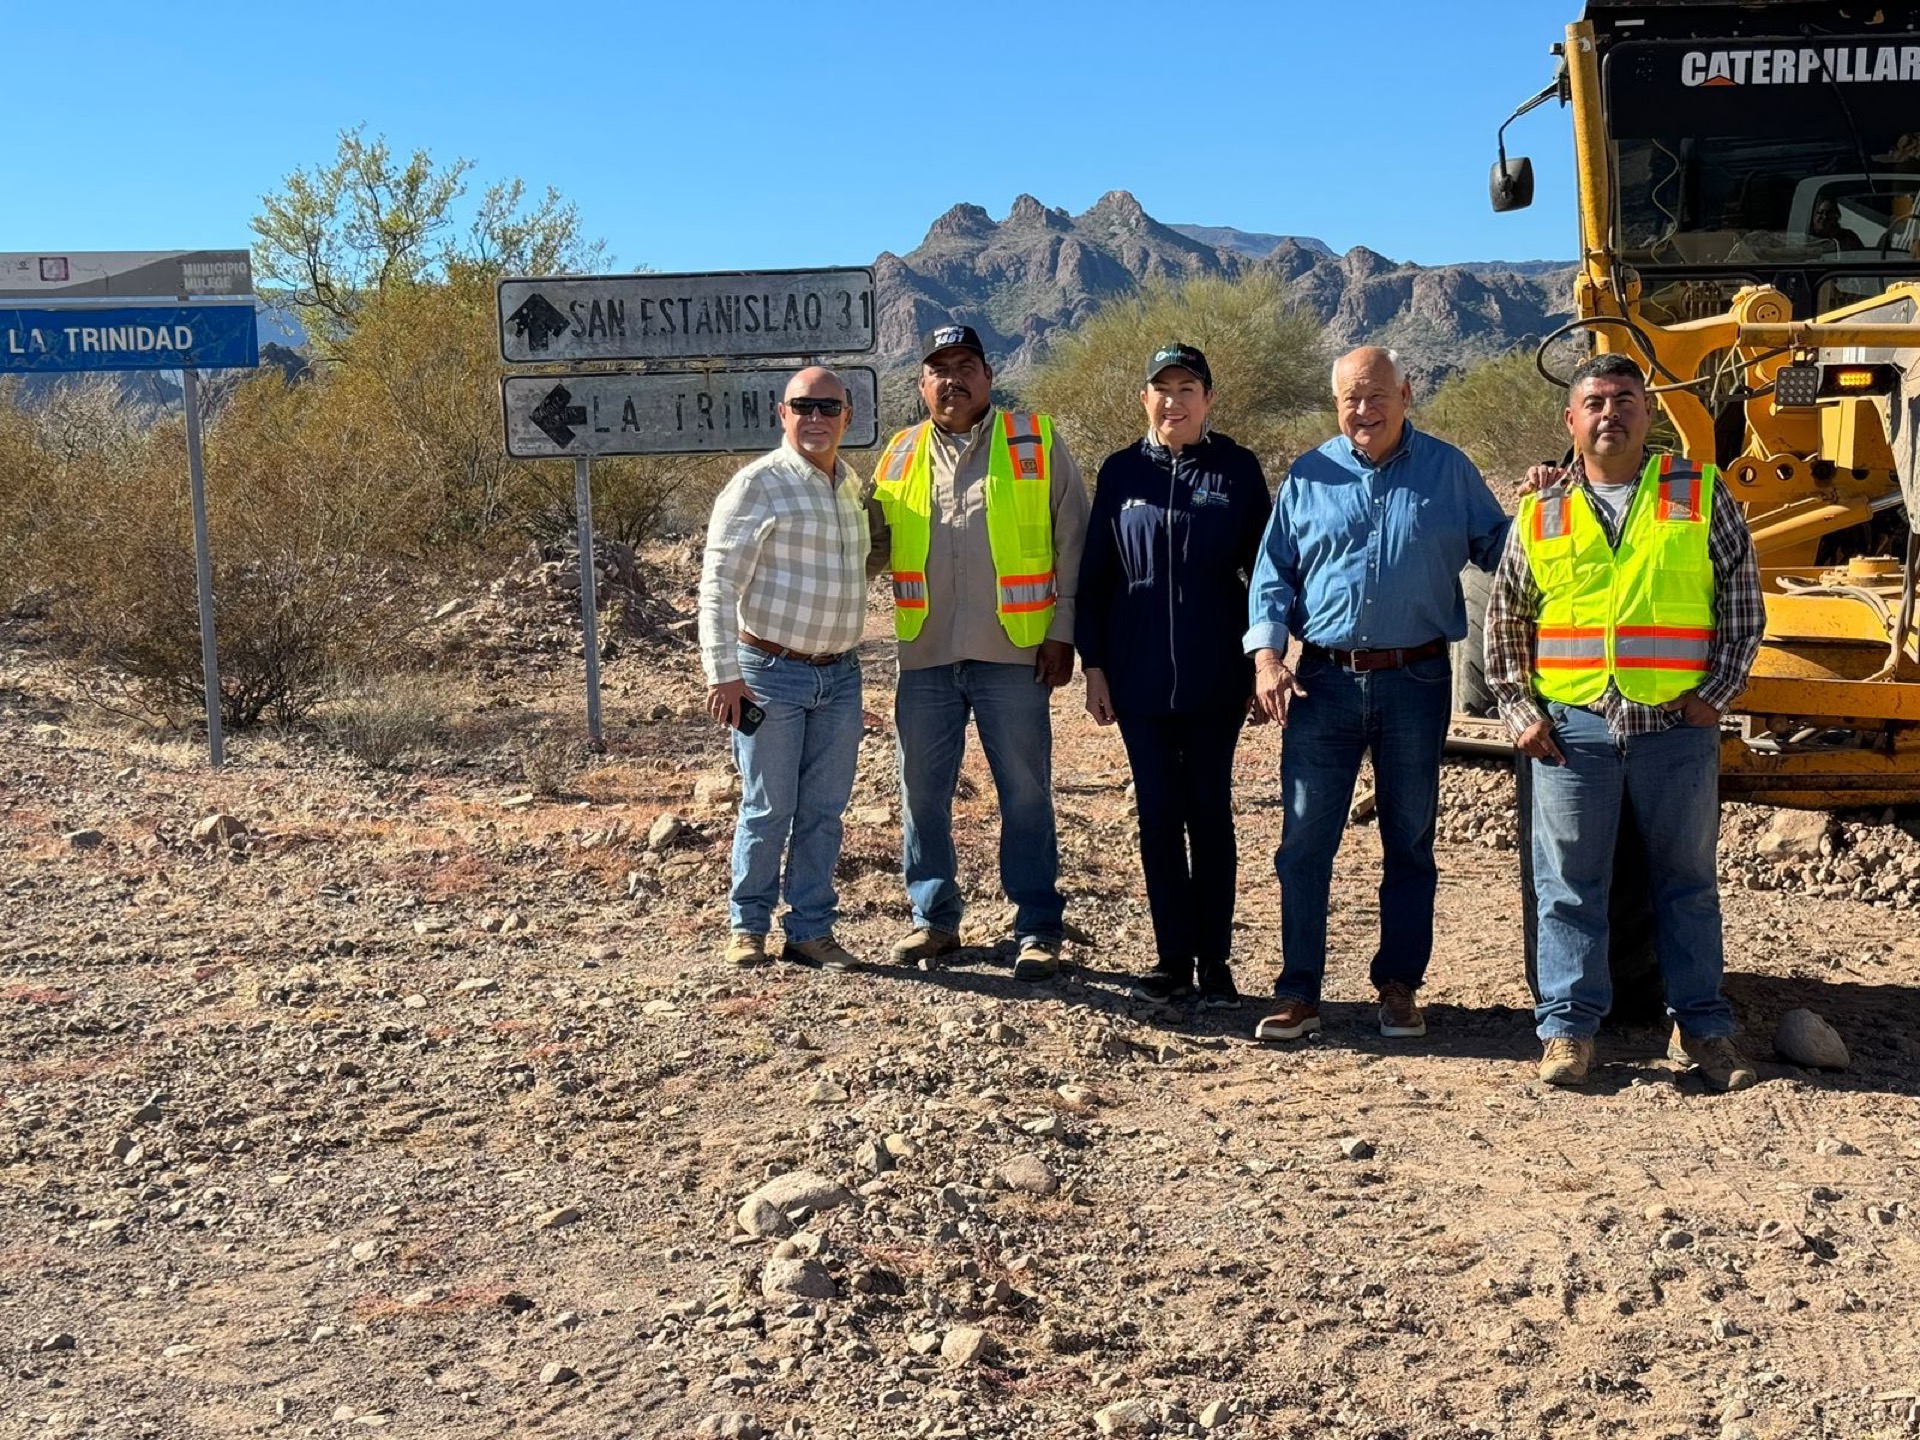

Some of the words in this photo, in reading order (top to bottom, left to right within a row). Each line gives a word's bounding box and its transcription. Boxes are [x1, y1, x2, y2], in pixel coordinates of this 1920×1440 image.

[1681, 46, 1920, 87] CATERPILLAR
[182, 262, 248, 275] MUNICIPIO
[569, 299, 626, 338] SAN
[640, 292, 822, 337] ESTANISLAO
[835, 289, 870, 330] 31
[9, 328, 47, 354] LA
[63, 325, 193, 353] TRINIDAD
[593, 395, 640, 433] LA
